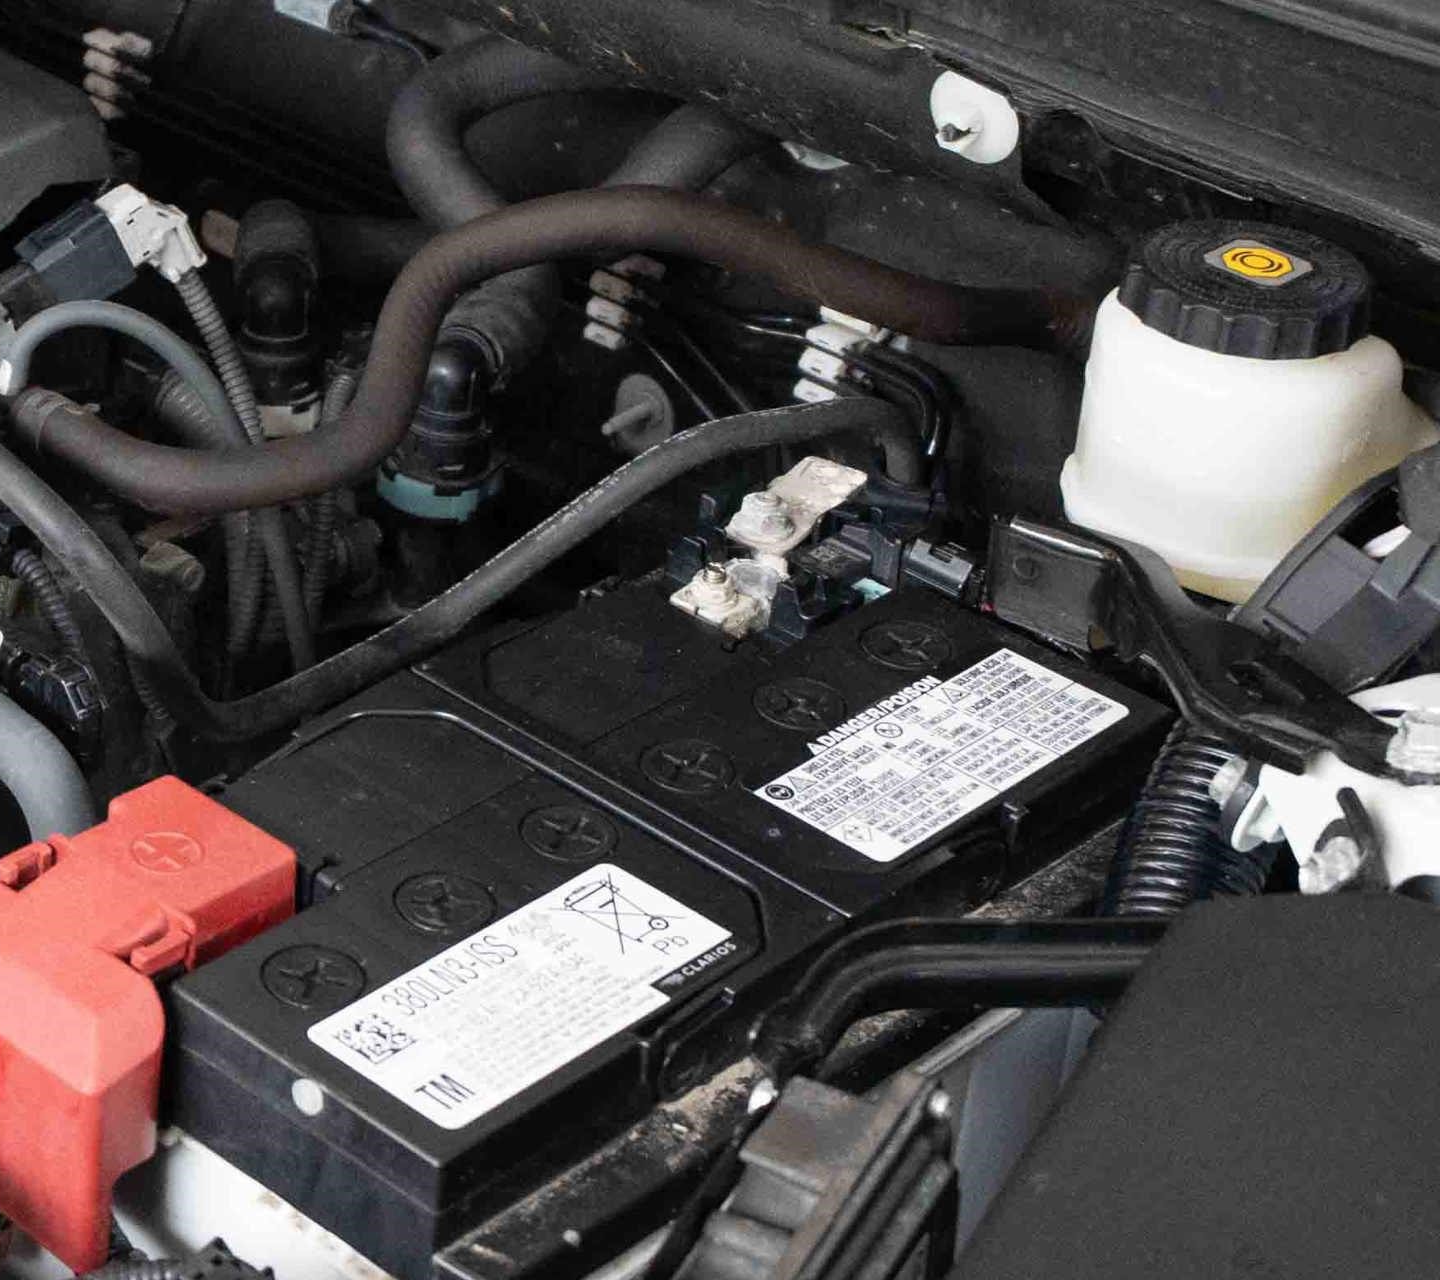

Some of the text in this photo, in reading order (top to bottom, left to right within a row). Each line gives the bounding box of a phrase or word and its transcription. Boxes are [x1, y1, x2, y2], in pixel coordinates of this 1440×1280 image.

[816, 675, 943, 748] DANGER/POISON
[381, 934, 520, 1018] 380LN3-ISS
[680, 941, 738, 977] CLARIOS
[413, 1072, 477, 1111] TM
